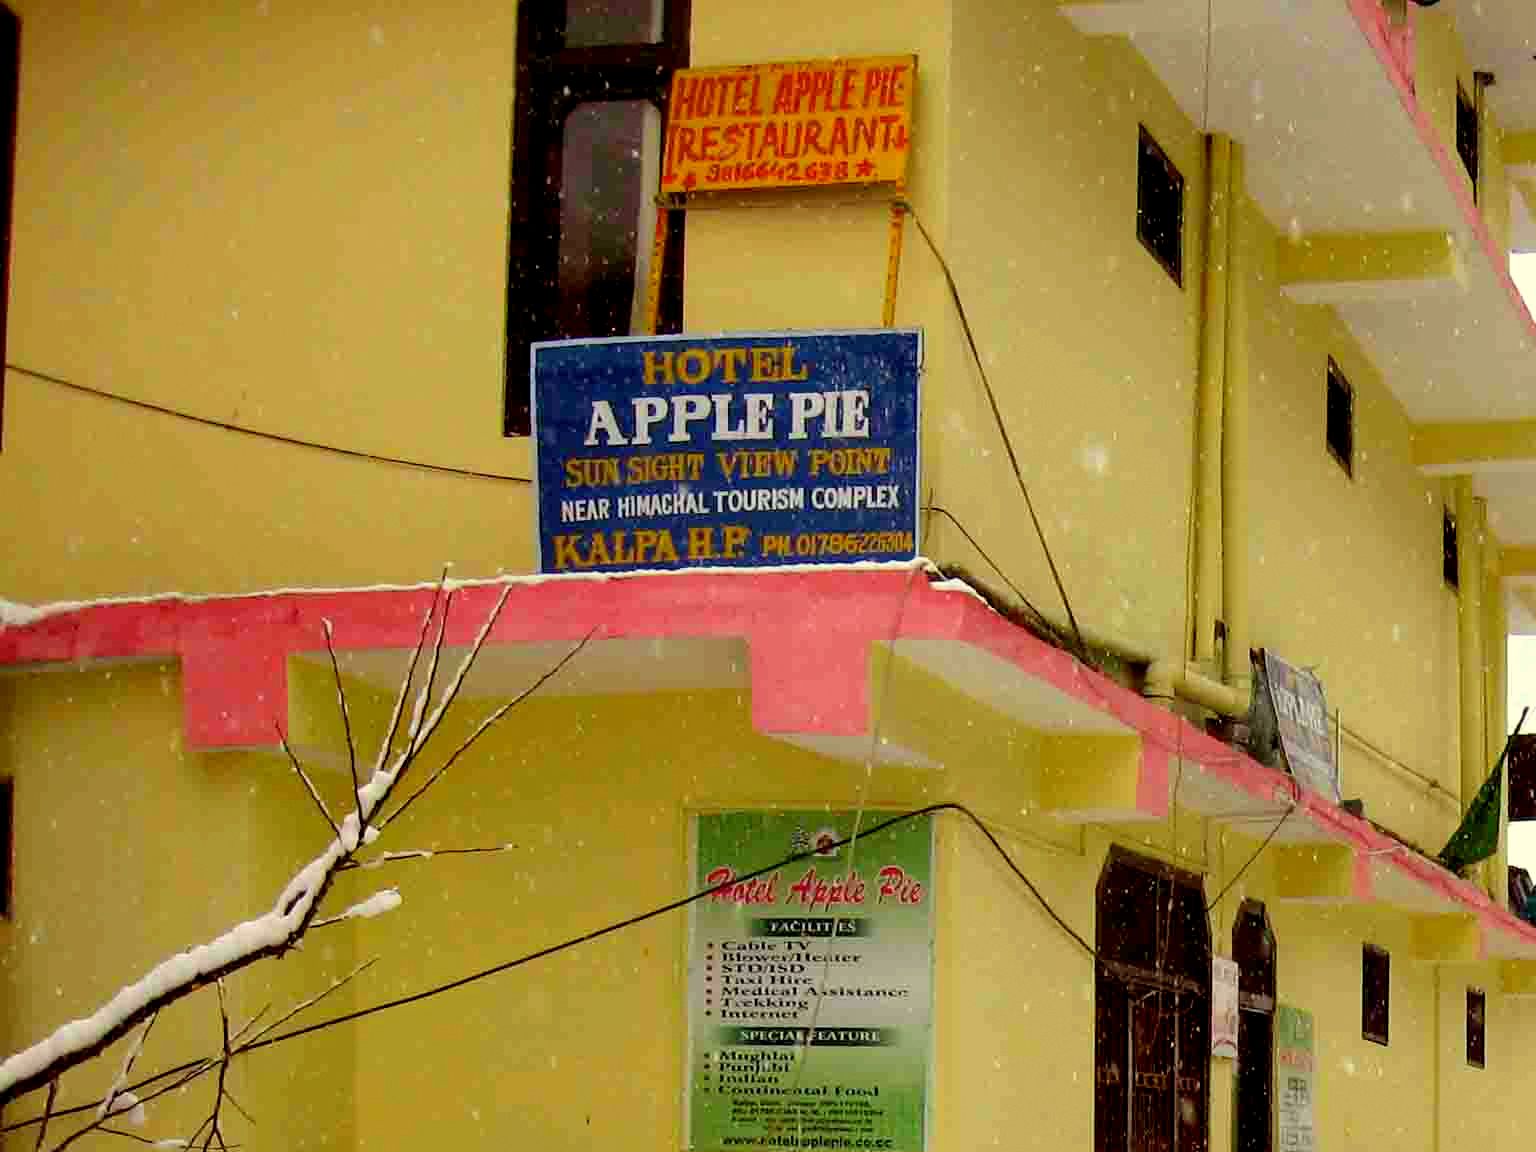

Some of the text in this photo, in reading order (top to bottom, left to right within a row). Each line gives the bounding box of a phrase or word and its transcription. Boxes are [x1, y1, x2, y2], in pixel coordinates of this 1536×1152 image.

[671, 64, 908, 122] HOTEL APPLE PIE
[677, 114, 900, 165] RESTAURANT
[642, 344, 808, 385] HOTEL
[583, 388, 872, 447] APPLE PIE
[565, 447, 892, 489] SUN SIGHT VIEW POINT
[560, 484, 900, 524] NEAR HIMACHAL TOURISM COMPLEX
[552, 527, 679, 570] KALPA
[705, 864, 927, 912] Hotel Apple Pie
[720, 941, 812, 952] Cable TV
[720, 975, 814, 985] Taxi Hire
[720, 986, 910, 999] Medical Assistance
[720, 999, 810, 1011] Trekking
[720, 1009, 800, 1020] Internet
